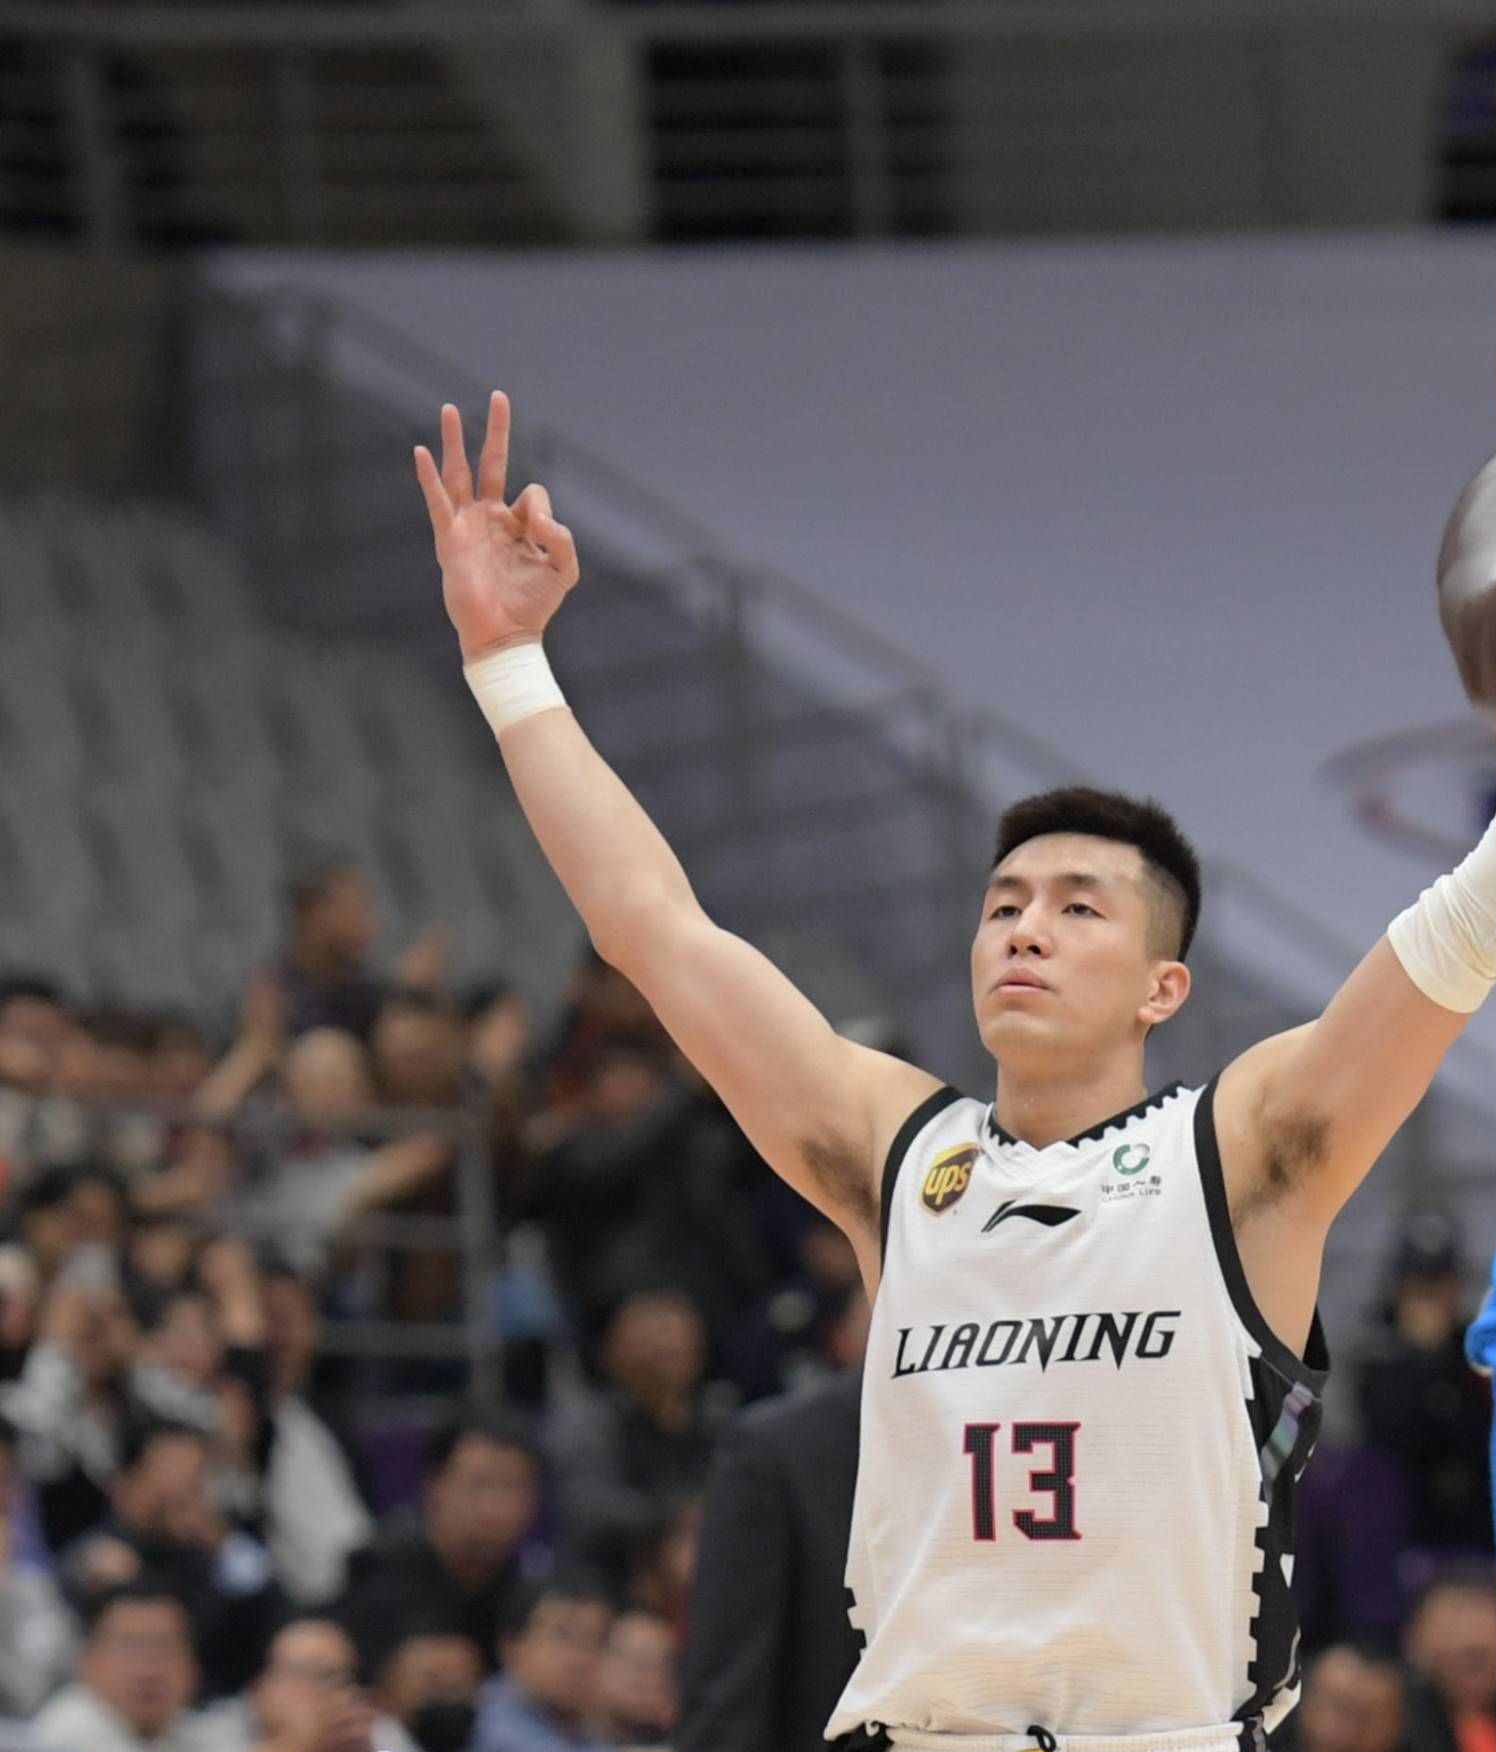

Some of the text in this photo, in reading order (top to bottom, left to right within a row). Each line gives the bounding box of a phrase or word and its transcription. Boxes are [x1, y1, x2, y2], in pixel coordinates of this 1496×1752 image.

[925, 1161, 972, 1206] ups
[890, 1310, 1182, 1379] LIAONING
[963, 1421, 1082, 1541] 13
